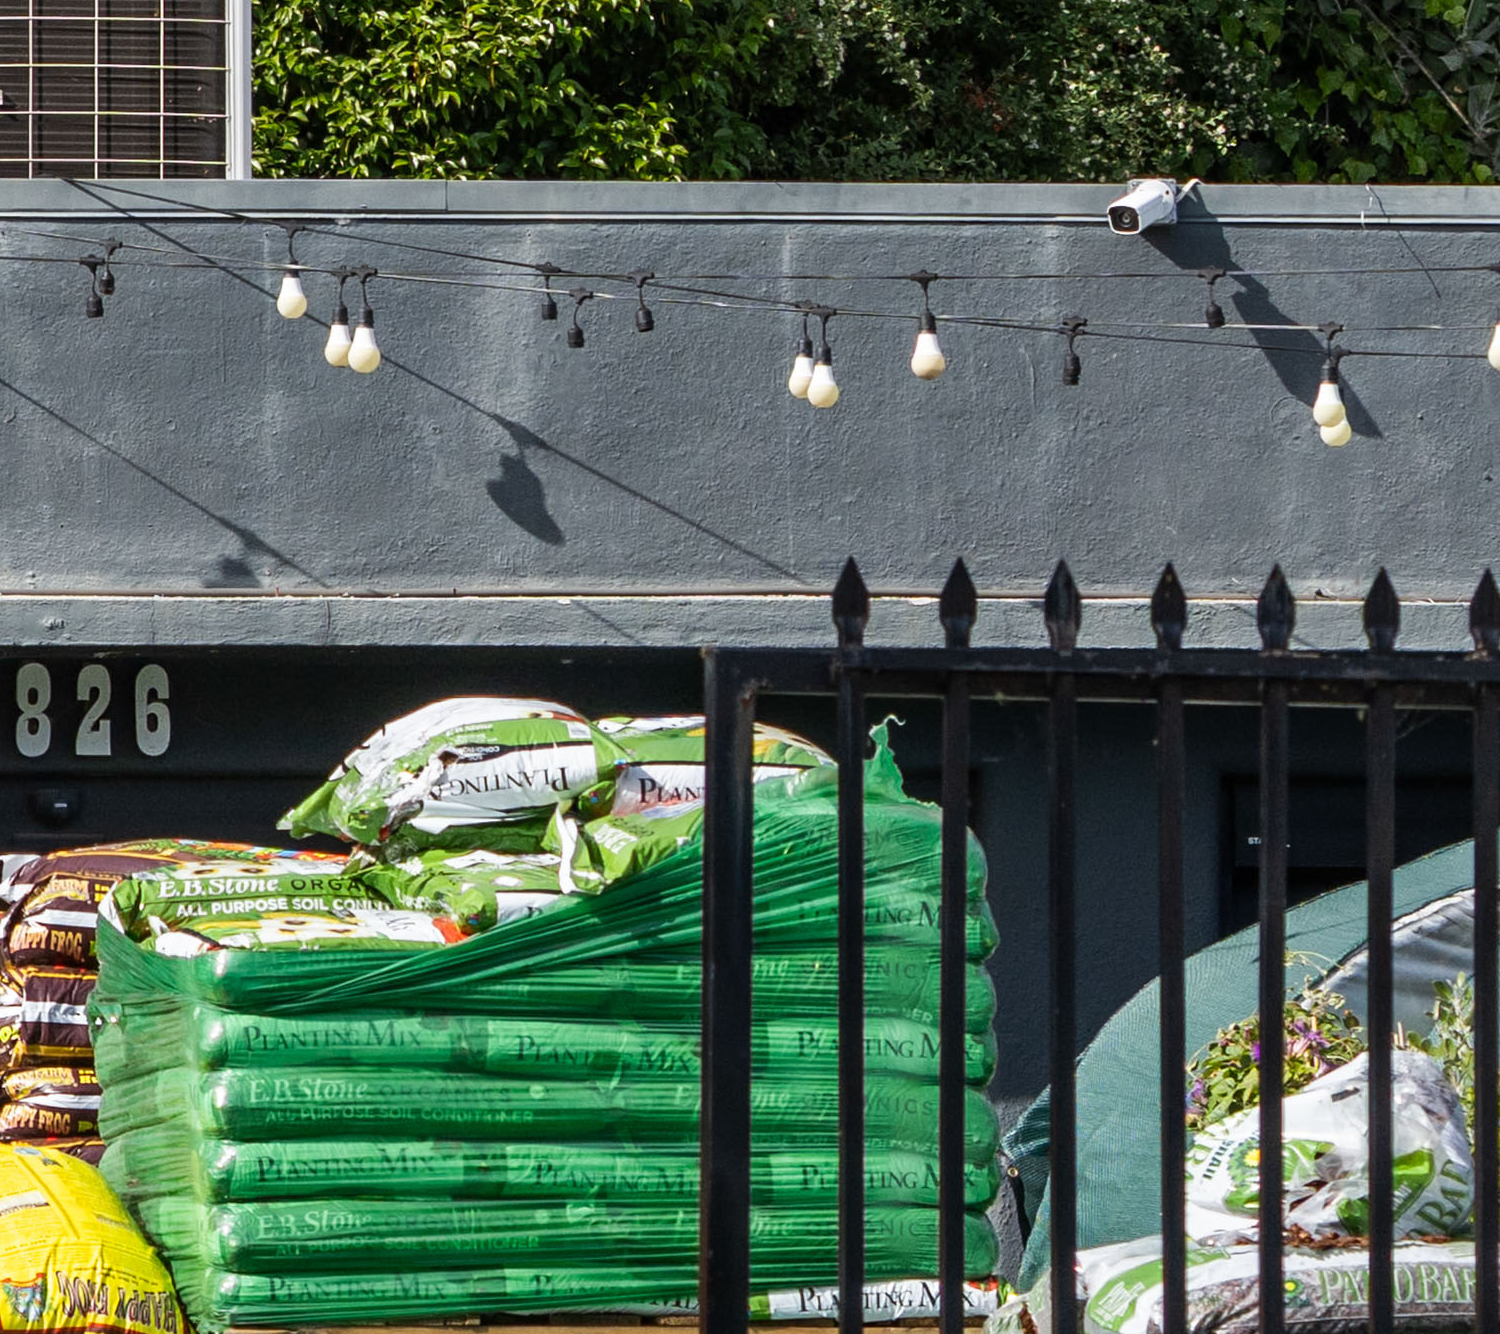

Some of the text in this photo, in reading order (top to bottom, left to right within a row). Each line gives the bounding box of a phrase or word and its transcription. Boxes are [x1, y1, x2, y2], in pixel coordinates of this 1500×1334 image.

[450, 767, 571, 797] PLANTING
[176, 897, 328, 918] ALL PURPOSE SOIL
[51, 930, 84, 959] FROG
[366, 1021, 423, 1048] MIX
[40, 1109, 72, 1135] FROG
[1320, 1265, 1476, 1305] PAO BAR
